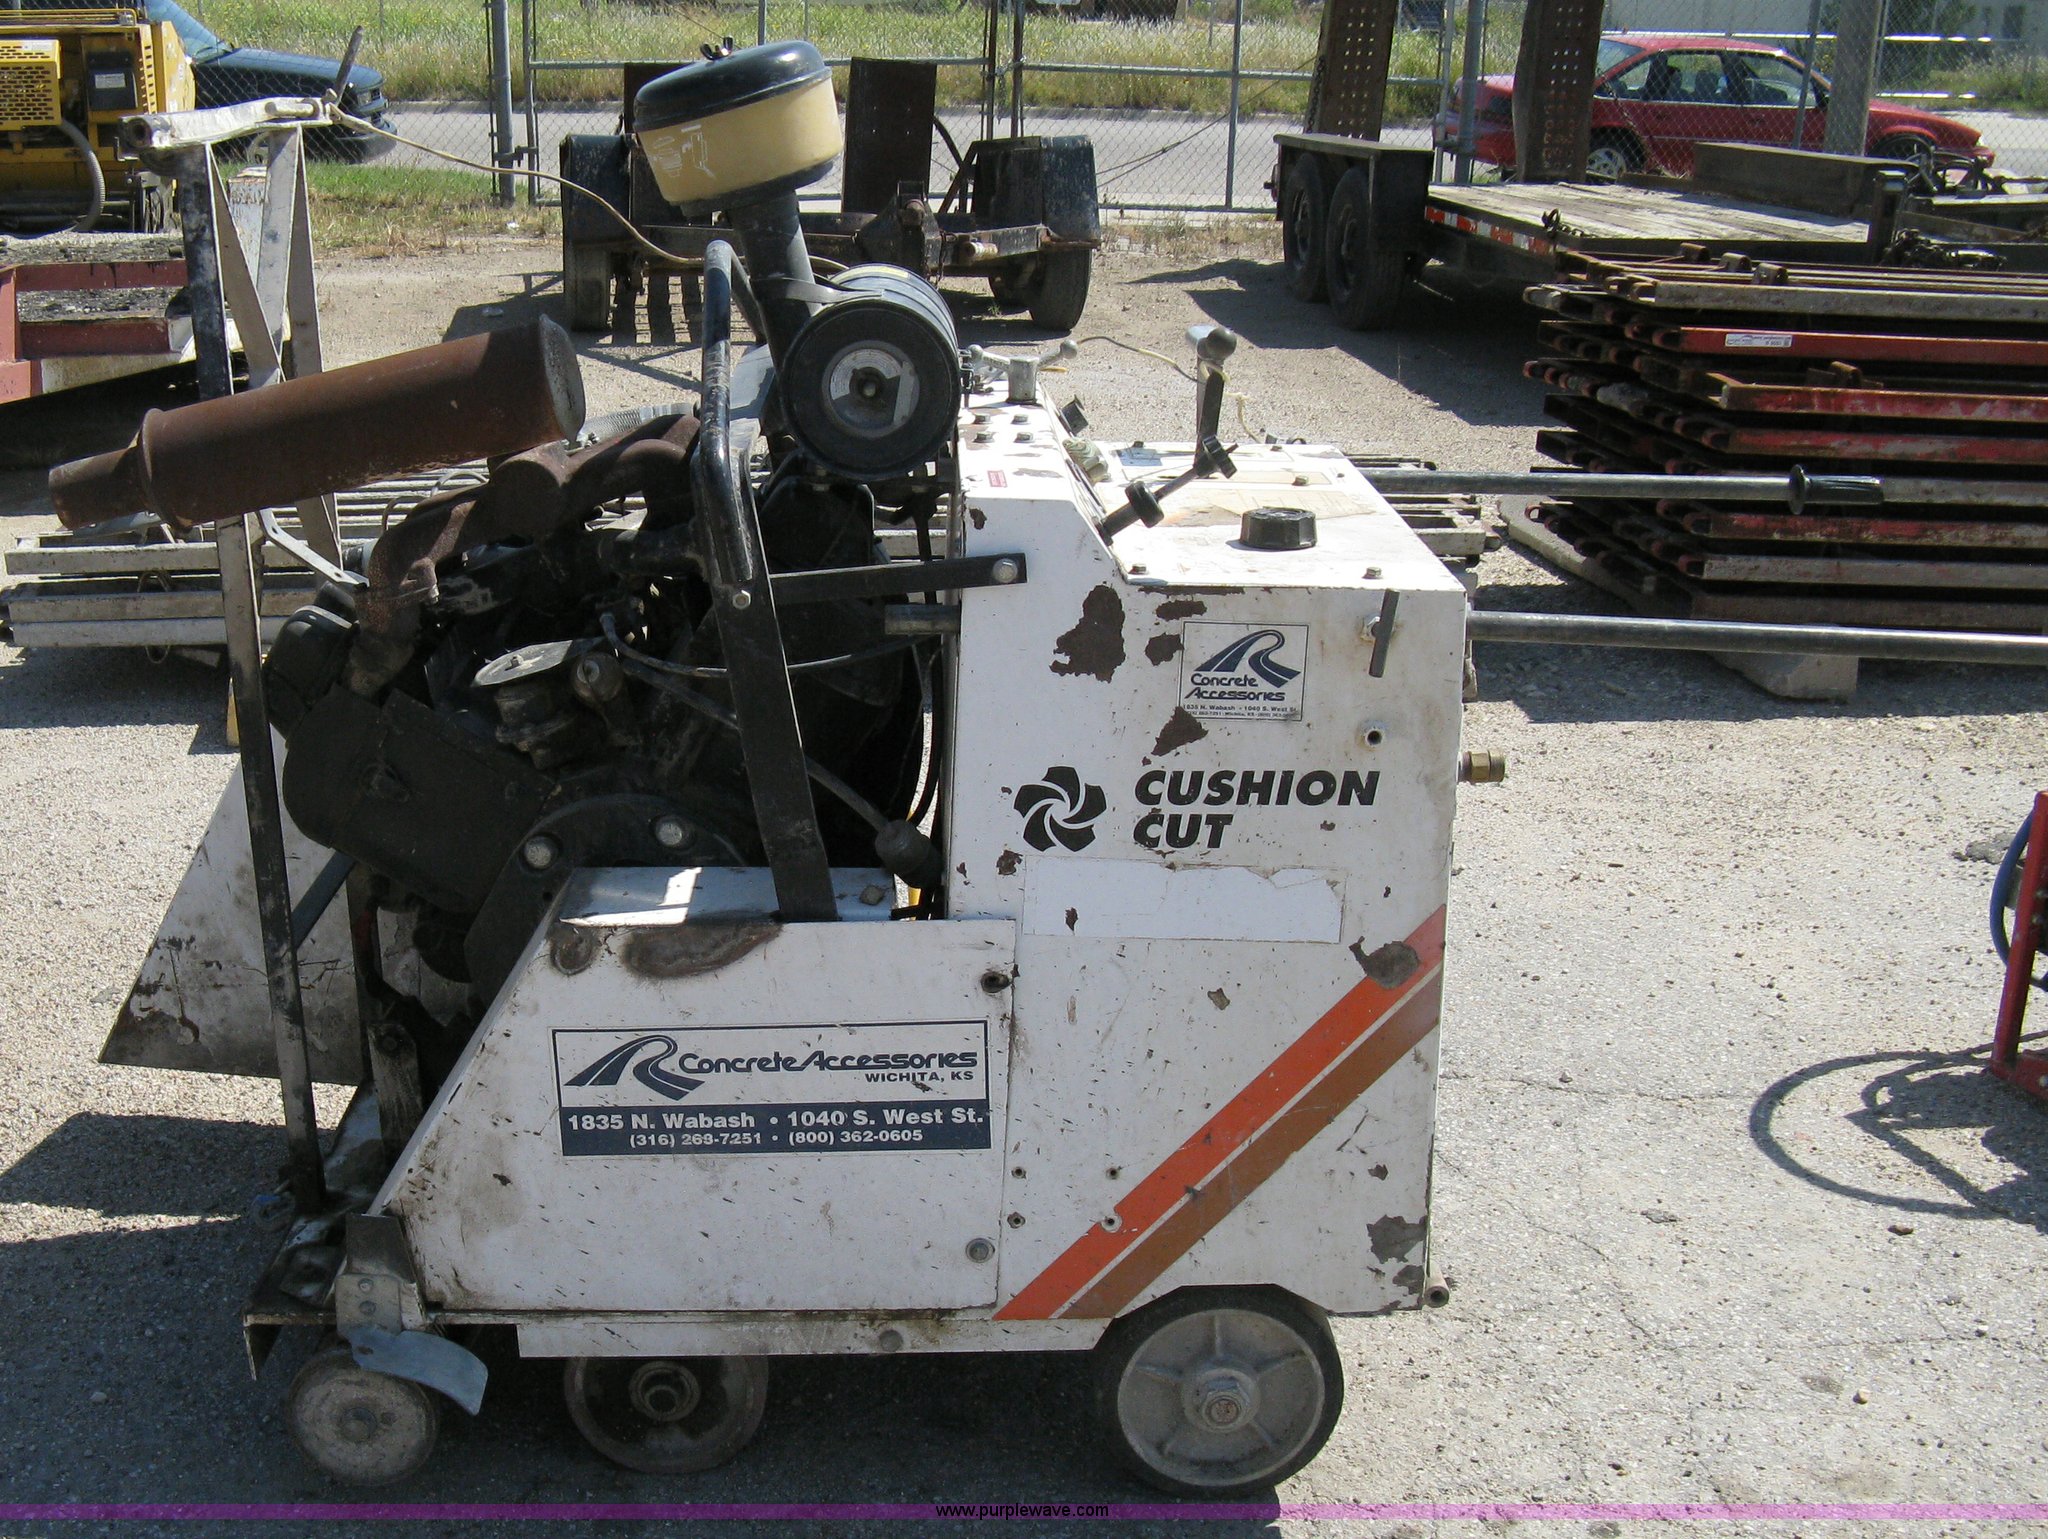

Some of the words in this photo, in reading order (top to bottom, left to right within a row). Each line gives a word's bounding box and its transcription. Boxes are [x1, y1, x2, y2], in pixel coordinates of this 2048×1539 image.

[1190, 672, 1258, 687] Concrete
[1184, 686, 1286, 701] Accessories
[1135, 770, 1380, 806] CUSHION
[1133, 813, 1233, 848] CUT
[679, 1051, 804, 1074] Concrete
[799, 1050, 978, 1071] Accessories
[865, 1072, 944, 1083] WICHITA,
[951, 1071, 974, 1081] KS
[568, 1114, 624, 1130] 1835
[631, 1113, 655, 1129] N.
[662, 1112, 755, 1129] Wabash
[787, 1110, 847, 1126] 1040
[852, 1109, 876, 1126] S.
[883, 1108, 943, 1125] West
[951, 1107, 984, 1123] St.
[629, 1134, 675, 1148] (316)
[788, 1131, 835, 1146] (800)
[840, 1129, 923, 1143] 362-0605
